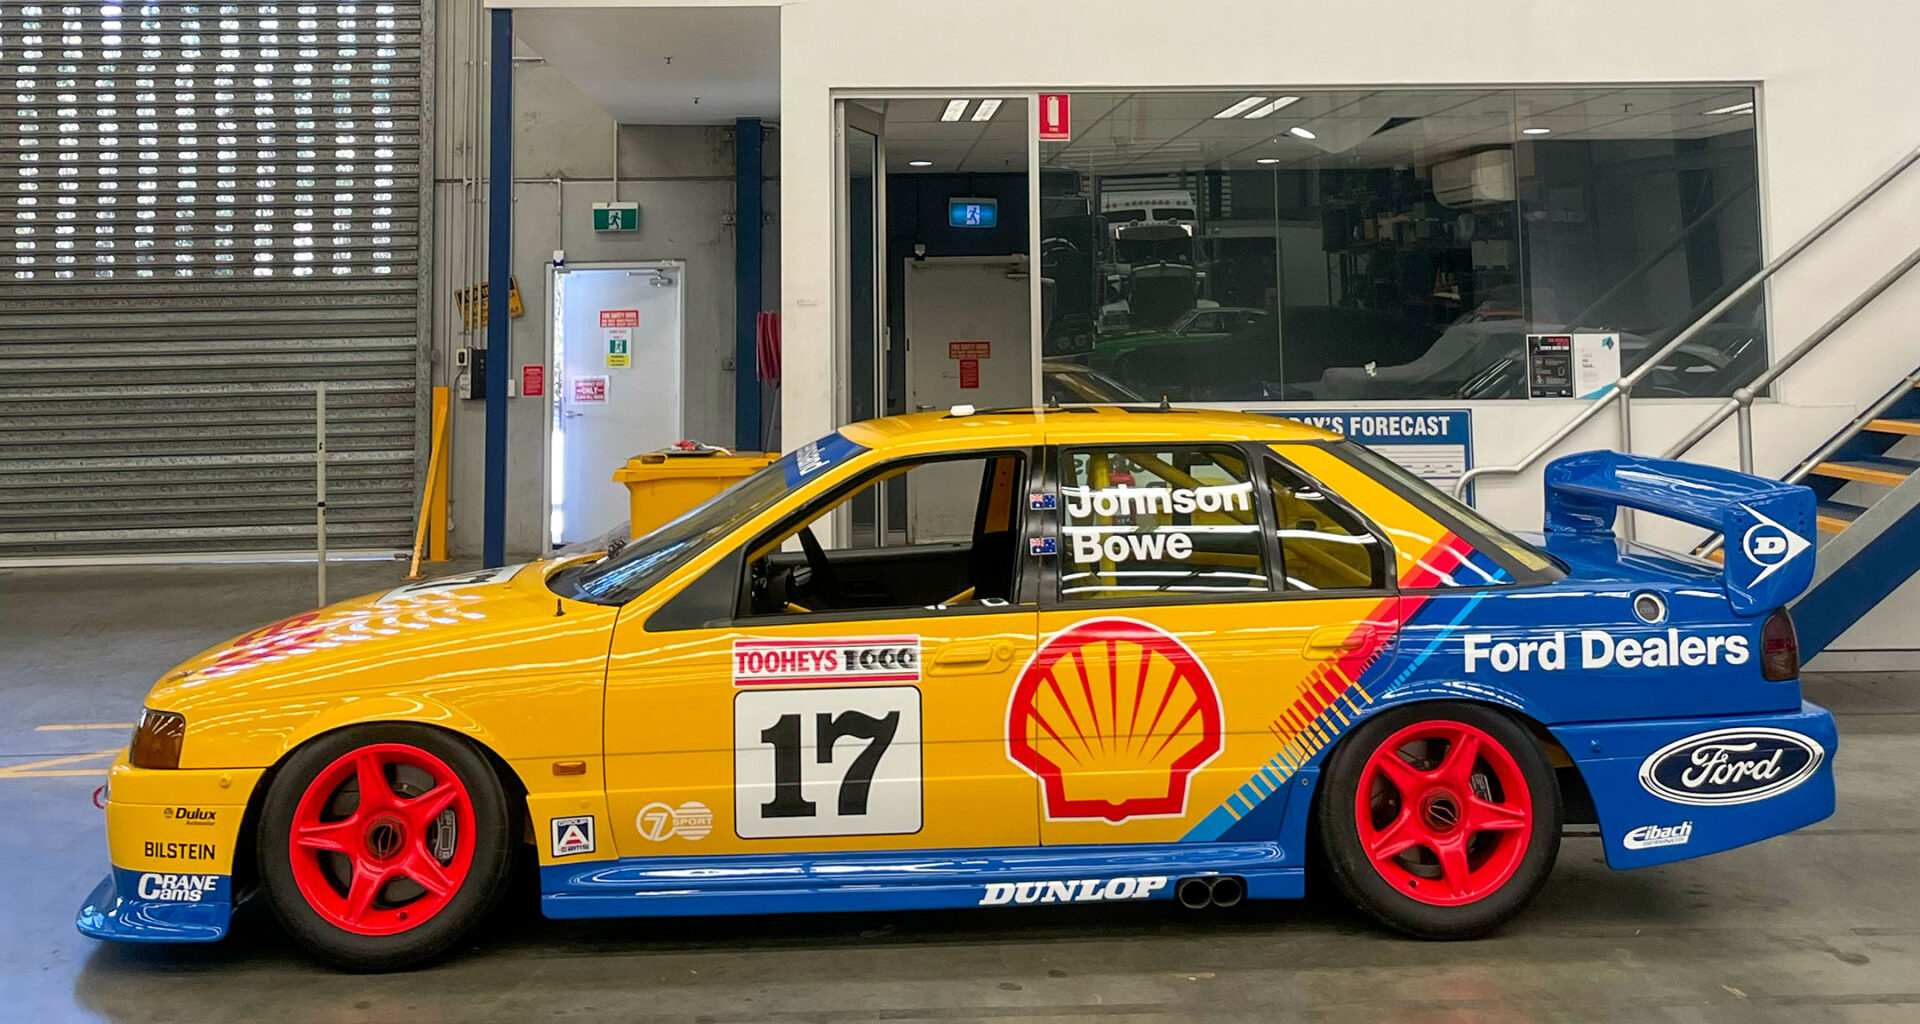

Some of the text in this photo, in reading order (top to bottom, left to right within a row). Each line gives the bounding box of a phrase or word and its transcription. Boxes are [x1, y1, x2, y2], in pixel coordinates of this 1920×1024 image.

[1350, 416, 1450, 436] FORECAST
[1067, 483, 1252, 518] Johnson
[1072, 531, 1193, 564] Bowe
[735, 649, 838, 673] TOOHEYS
[1464, 628, 1749, 673] Ford Dealers
[760, 710, 901, 819] 17
[1681, 742, 1783, 788] Ford
[175, 807, 217, 820] Dulux
[672, 817, 712, 826] SPORT
[1623, 821, 1693, 850] Eibach
[144, 841, 216, 860] BILSTEIN
[138, 873, 219, 900] CRANE
[978, 876, 1167, 906] DUNLOP
